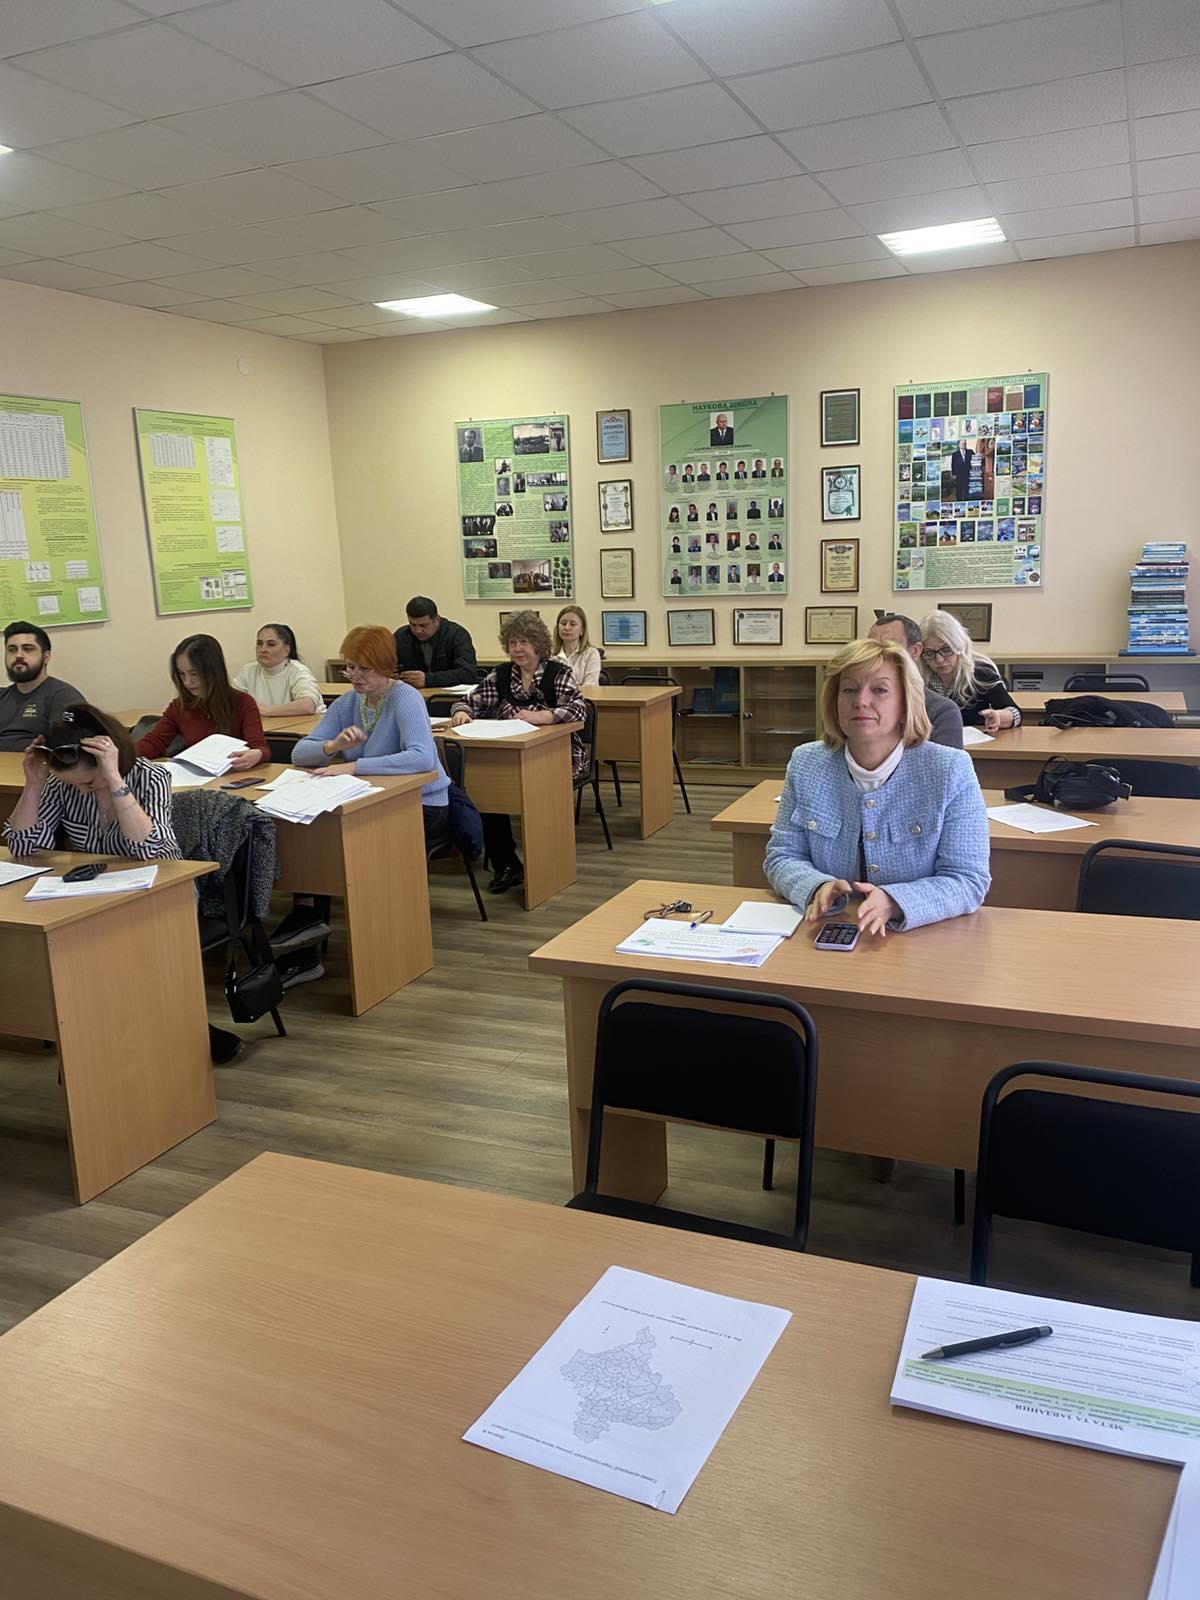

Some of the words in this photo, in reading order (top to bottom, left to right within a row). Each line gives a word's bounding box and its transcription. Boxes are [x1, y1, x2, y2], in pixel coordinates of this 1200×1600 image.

[692, 402, 728, 411] НАУКОВА
[729, 399, 758, 408] ШКОЛА
[1076, 1416, 1092, 1425] ТА
[1095, 1419, 1124, 1431] МЕТА
